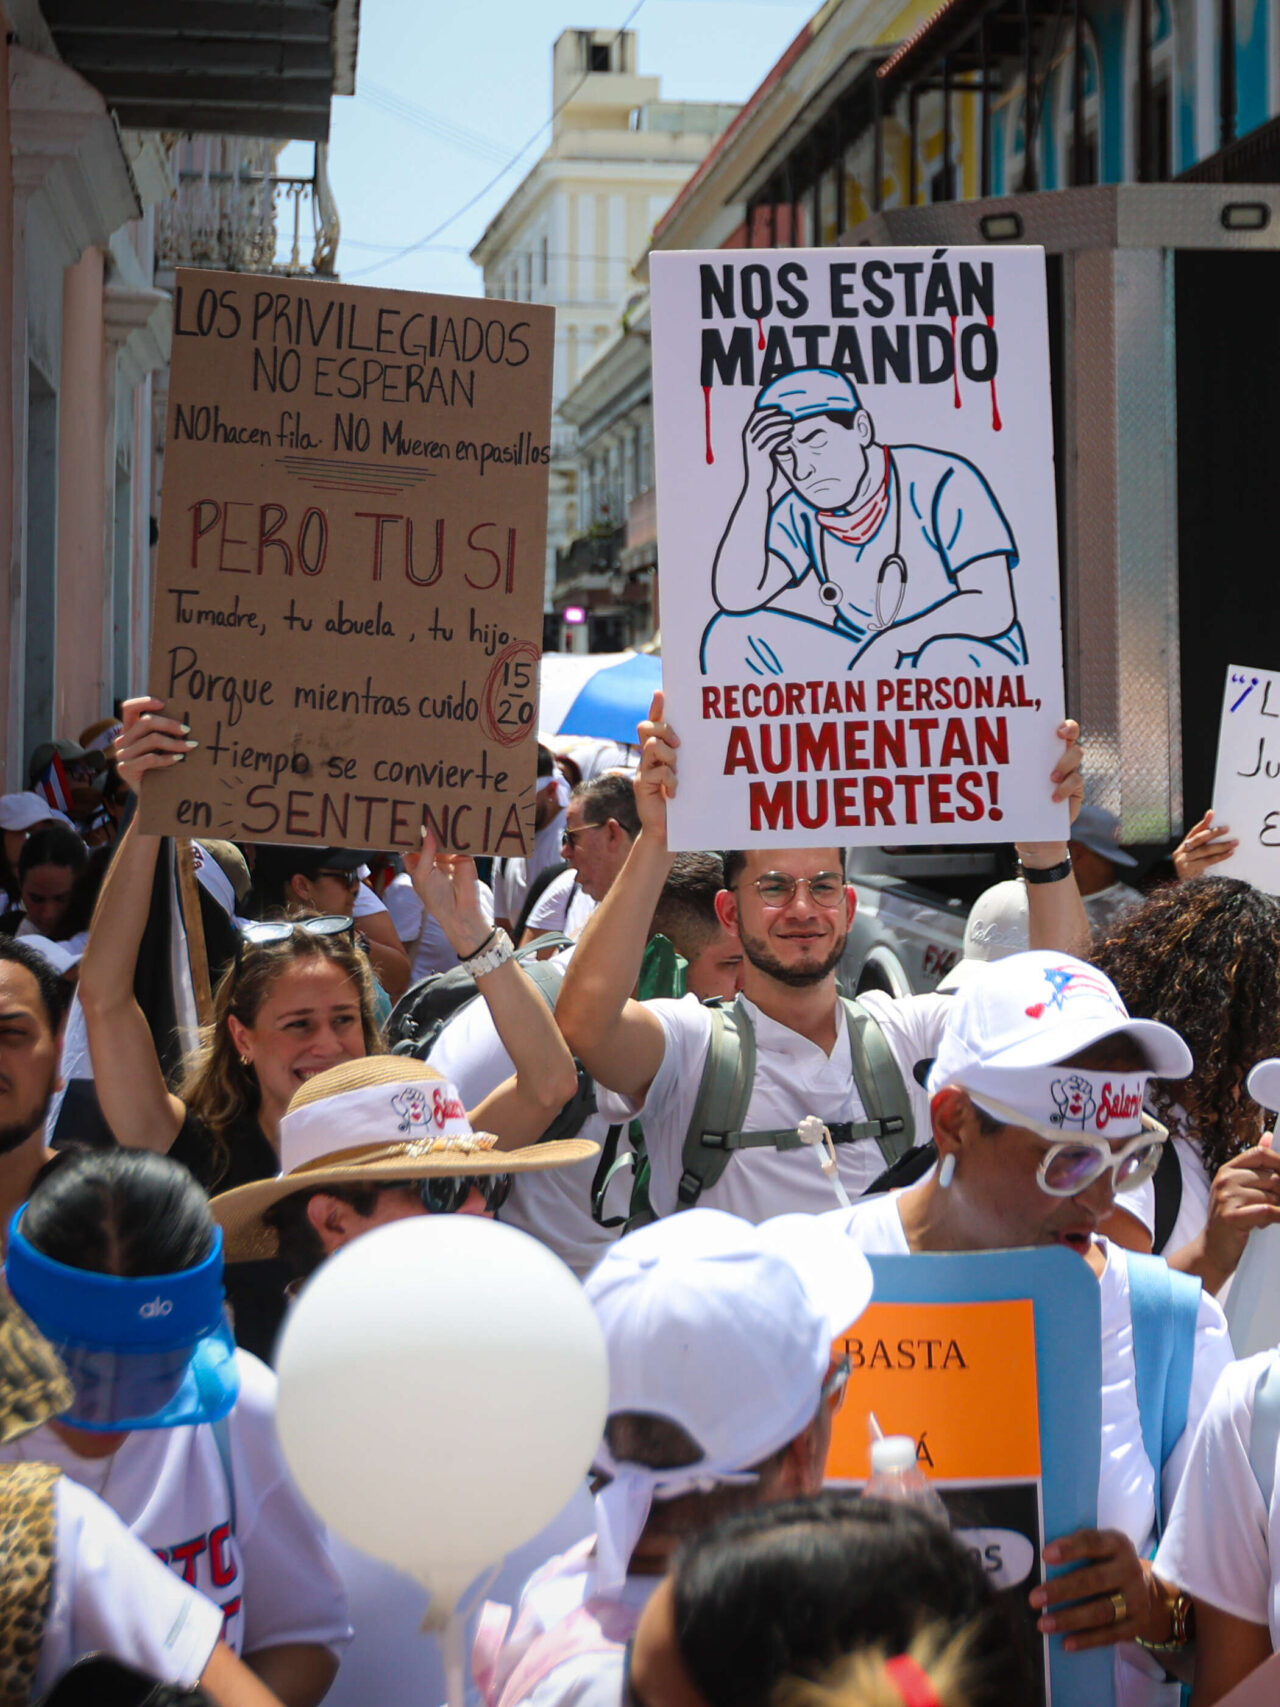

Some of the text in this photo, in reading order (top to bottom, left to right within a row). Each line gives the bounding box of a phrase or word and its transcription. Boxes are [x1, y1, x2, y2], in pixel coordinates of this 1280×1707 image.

[699, 249, 994, 320] NOS ESTÁN
[175, 286, 530, 366] LOS PRIVILEGIADOS
[700, 322, 998, 387] MATANDO
[253, 346, 475, 407] NO ESPERAN
[276, 412, 323, 450] fila.
[334, 413, 370, 452] NO
[383, 421, 450, 461] Mueren
[187, 499, 517, 595] PERO TU SI
[283, 599, 313, 633] tu
[428, 607, 453, 642] tu
[167, 646, 479, 727] Porque mientras cuido
[503, 662, 532, 689] 15
[701, 674, 1042, 720] RECORTAN PERSONAL,
[496, 699, 534, 725] 20
[205, 720, 311, 785] tiempo
[327, 756, 357, 780] se
[373, 749, 509, 793] convierte
[723, 715, 1010, 776] AUMENTAN
[176, 783, 528, 855] en SENTENCIA
[749, 770, 1004, 832] MUERTES!
[139, 1296, 173, 1318] alo
[843, 1338, 969, 1370] BASTA
